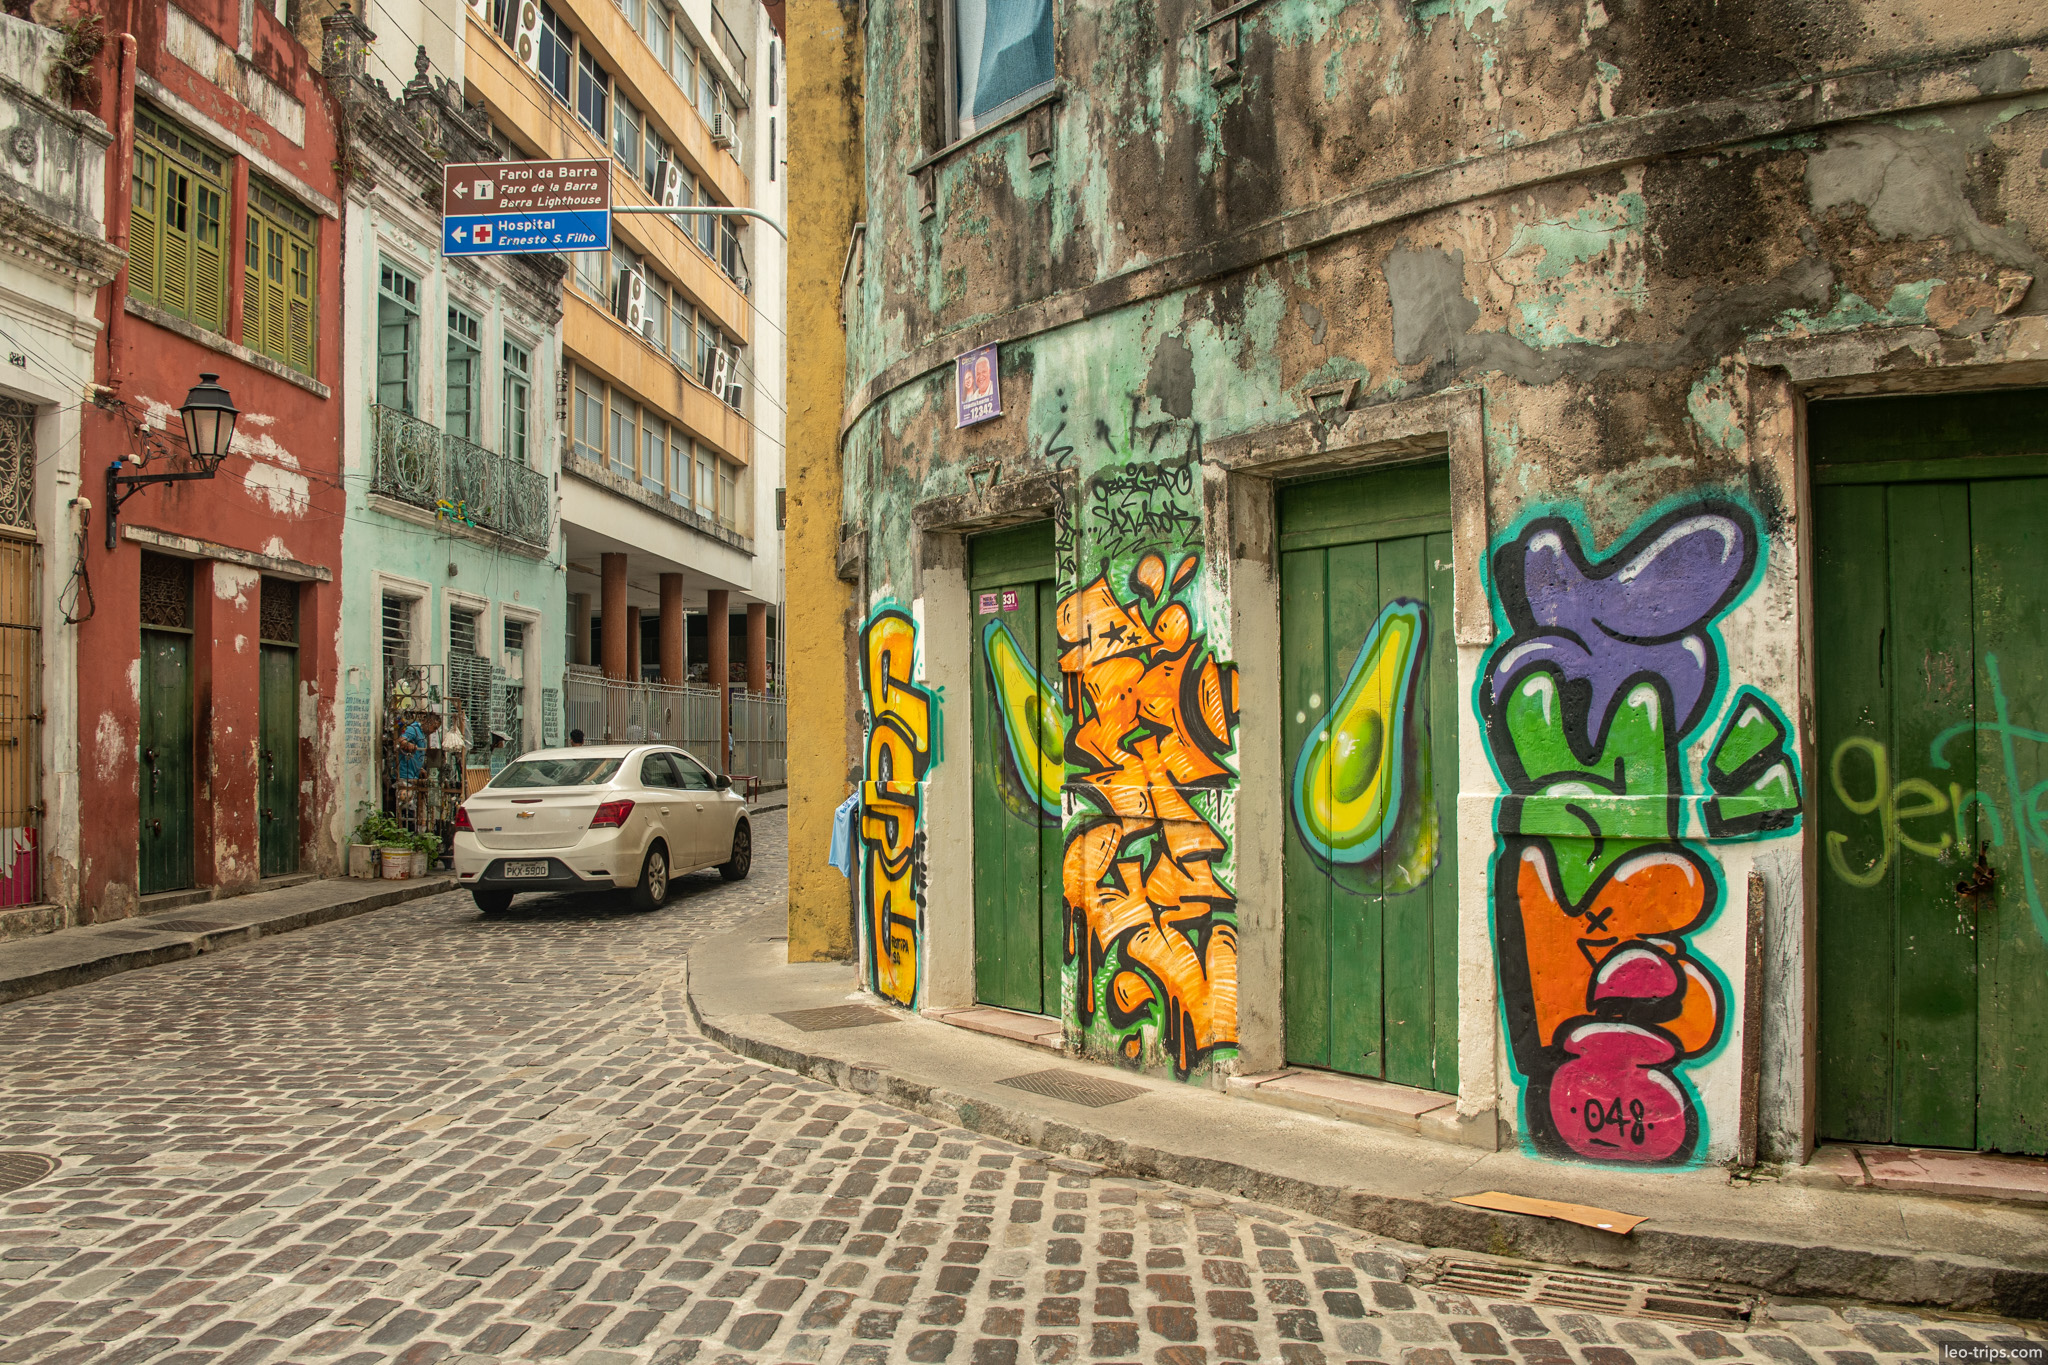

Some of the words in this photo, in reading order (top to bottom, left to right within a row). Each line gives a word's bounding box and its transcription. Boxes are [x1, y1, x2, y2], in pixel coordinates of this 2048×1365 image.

[499, 168, 533, 180] Farol
[537, 168, 554, 179] da
[558, 167, 598, 178] Barra
[499, 184, 526, 195] Faro
[531, 183, 544, 193] de
[549, 182, 559, 192] la
[564, 181, 598, 192] Barra
[499, 198, 533, 208] Barra
[537, 196, 602, 209] Lighthouse
[498, 219, 555, 233] Hospital
[498, 235, 548, 246] Ernesto
[553, 233, 563, 243] S.
[566, 232, 596, 243] Filho
[970, 402, 993, 419] 12342
